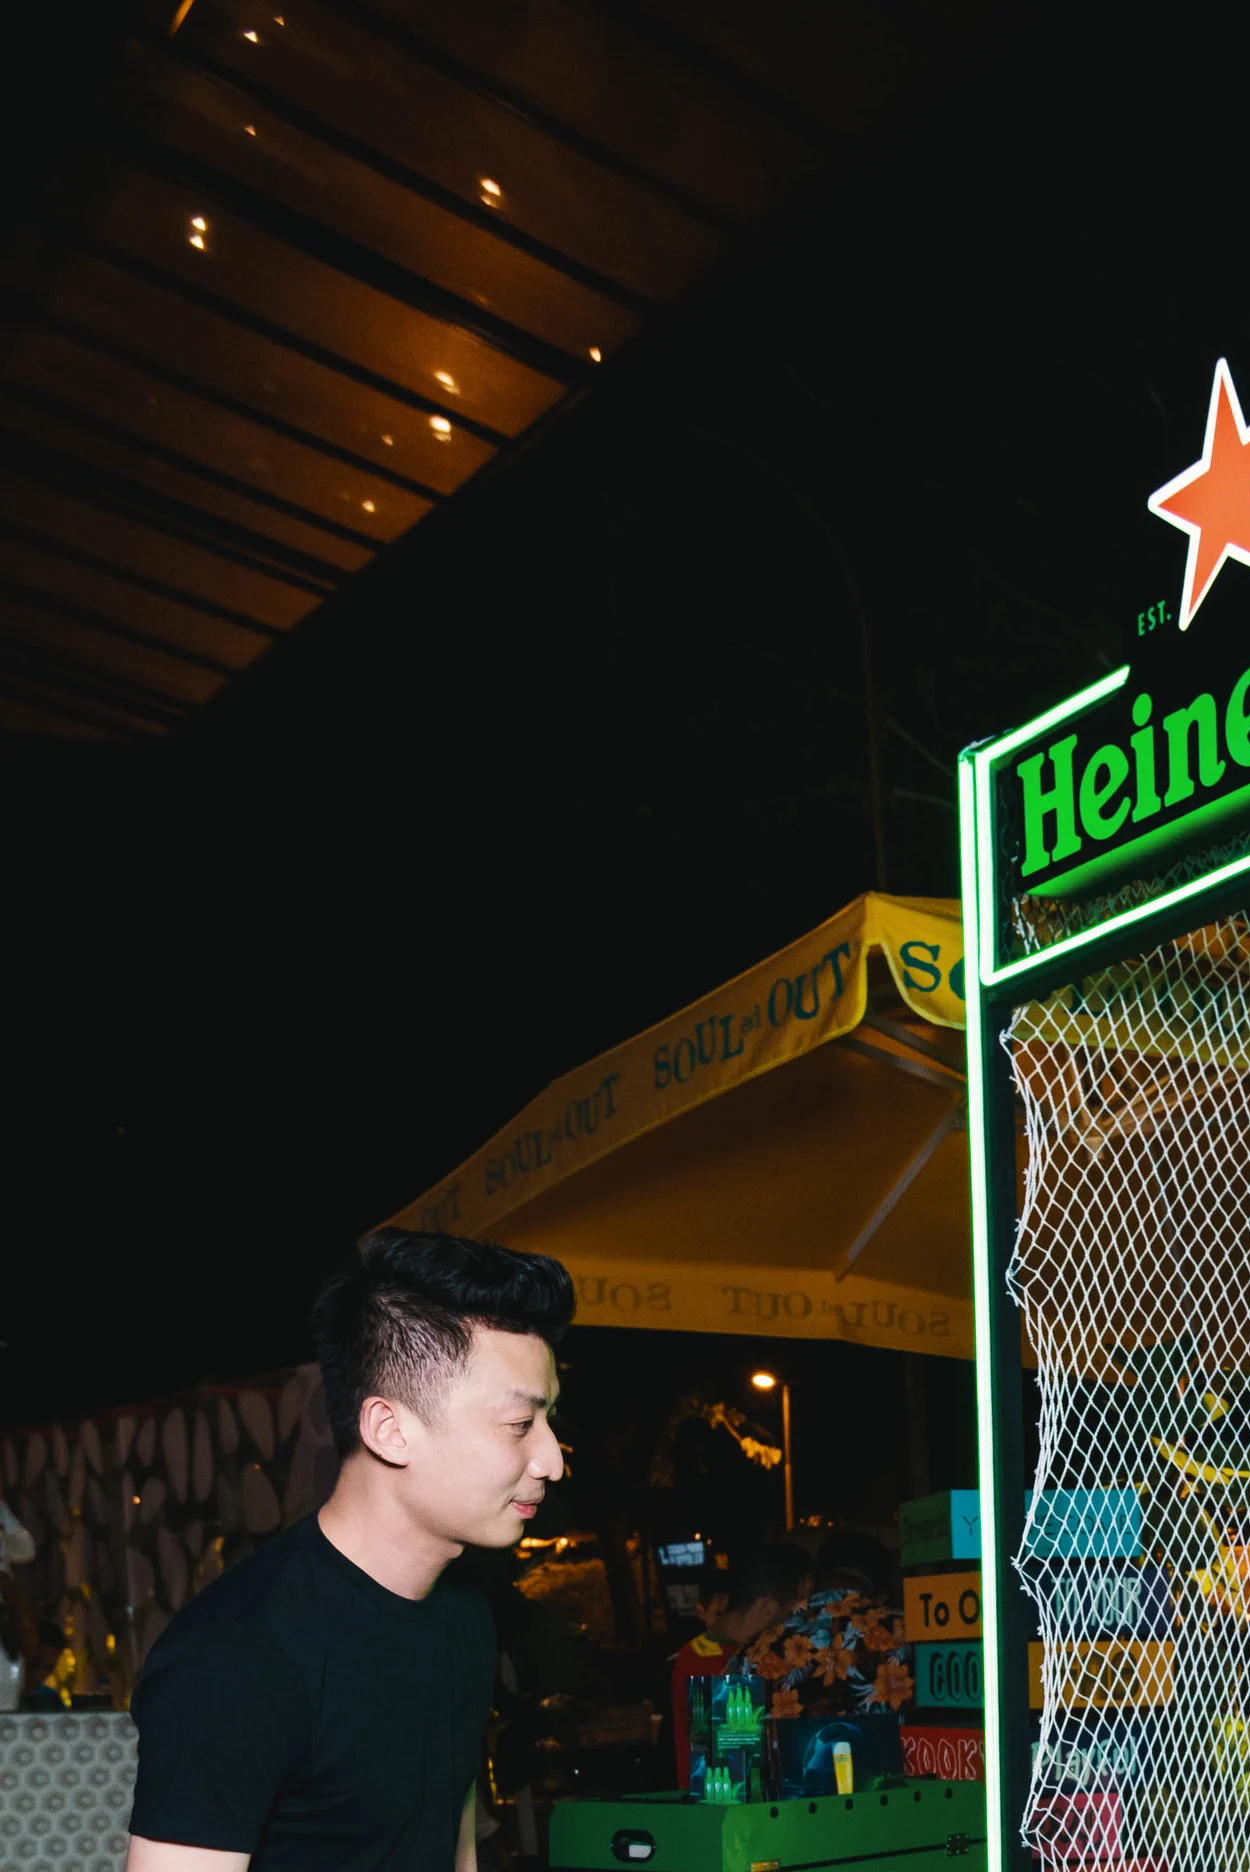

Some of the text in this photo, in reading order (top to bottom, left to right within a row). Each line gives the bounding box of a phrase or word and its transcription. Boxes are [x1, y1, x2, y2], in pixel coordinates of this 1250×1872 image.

[1137, 600, 1172, 637] EST.
[653, 1014, 745, 1090] SOUL
[768, 942, 851, 1028] OUT
[484, 1073, 620, 1196] SOUL OUT
[919, 1592, 949, 1628] To
